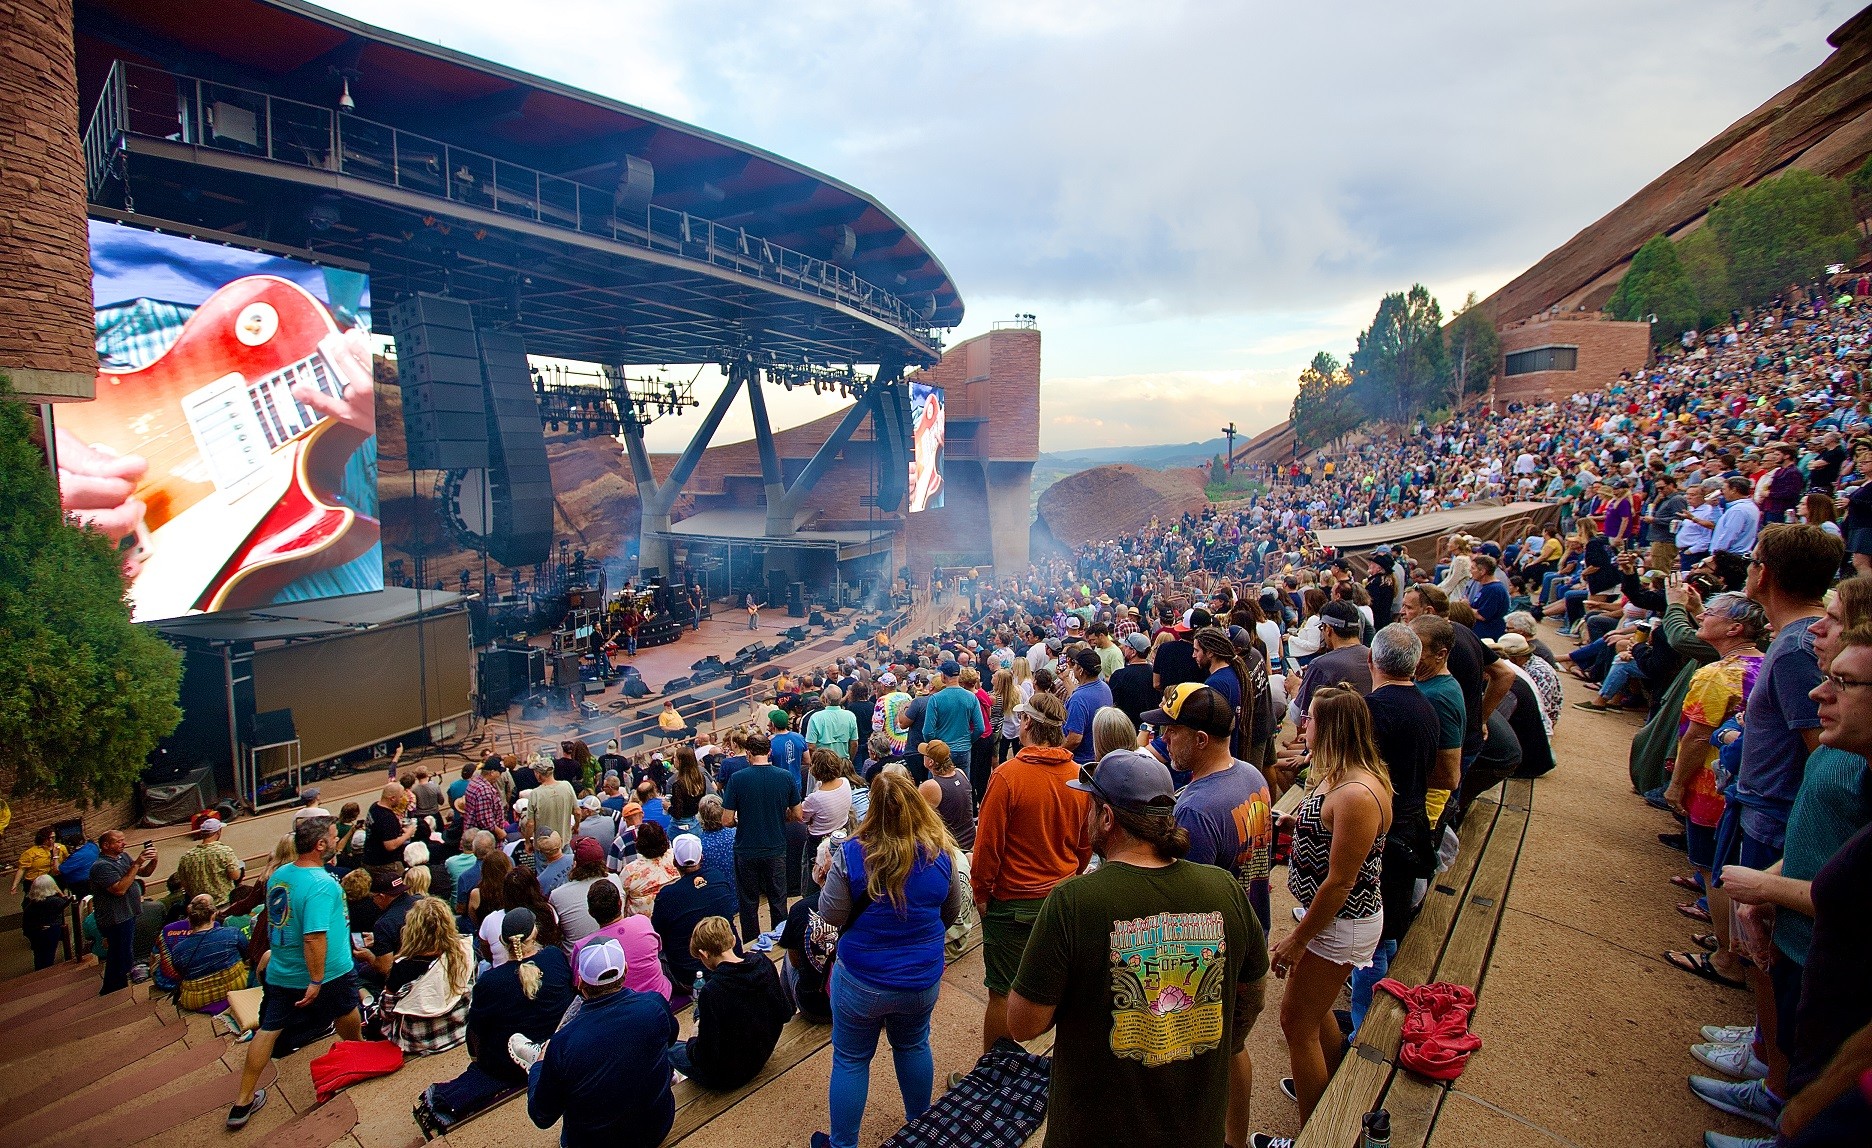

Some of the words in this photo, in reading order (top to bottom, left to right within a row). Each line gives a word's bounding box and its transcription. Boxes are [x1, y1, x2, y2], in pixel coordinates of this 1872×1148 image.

[1143, 961, 1161, 990] 5
[1161, 958, 1179, 971] OF
[1180, 956, 1200, 986] 7
